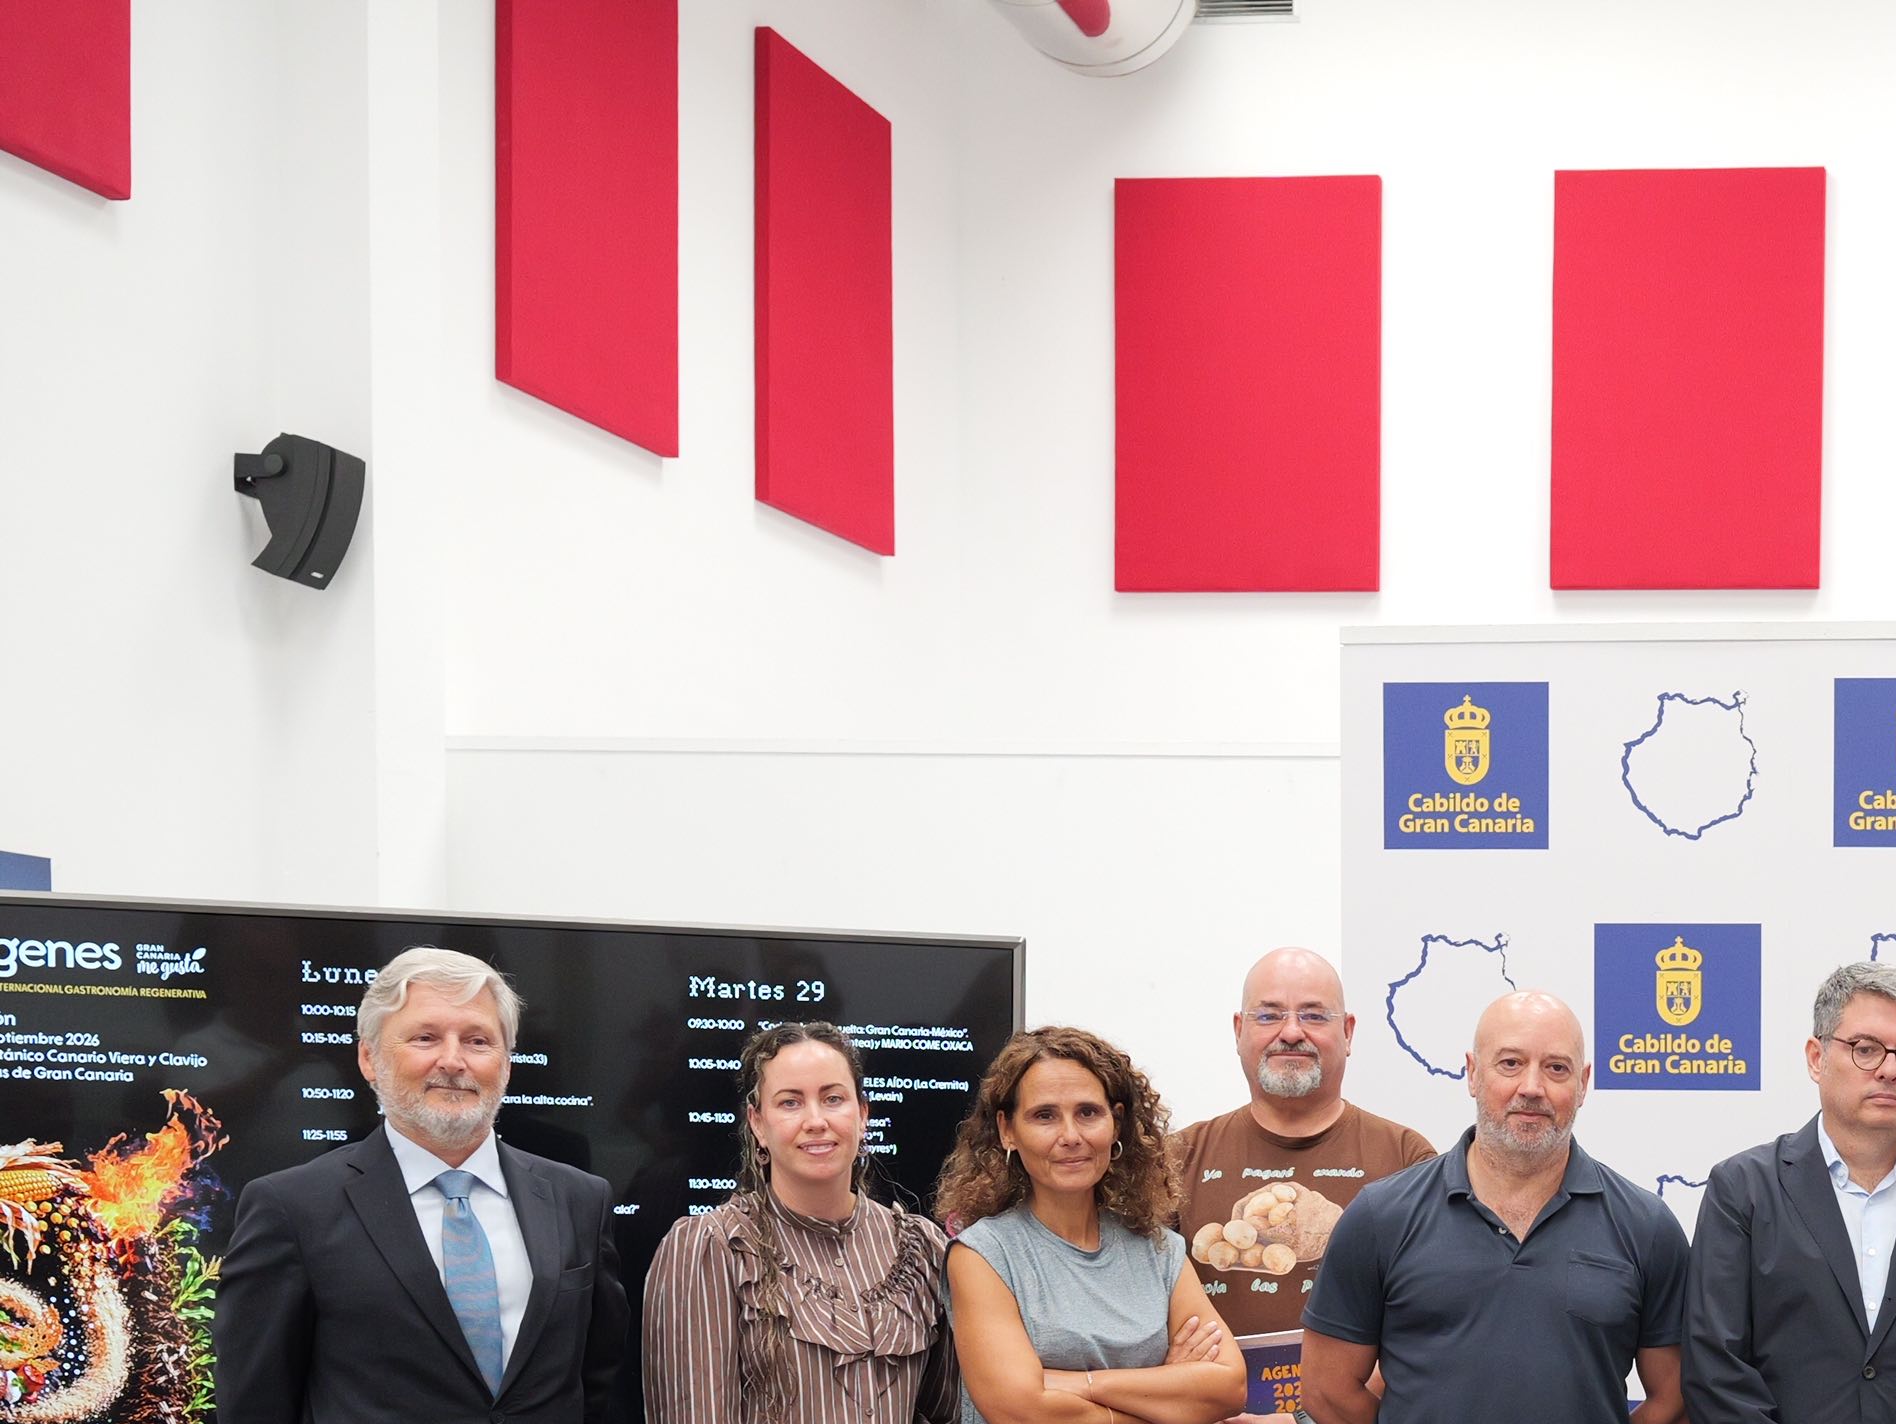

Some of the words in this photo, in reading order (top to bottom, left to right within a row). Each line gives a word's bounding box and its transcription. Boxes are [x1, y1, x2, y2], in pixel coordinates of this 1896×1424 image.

[1408, 793, 1490, 812] Cabildo
[1494, 793, 1521, 812] de
[1398, 814, 1450, 833] Gran
[1454, 814, 1535, 833] Canaria
[135, 943, 165, 952] GRAN
[135, 951, 181, 961] CANARIA
[0, 937, 123, 978] genes
[136, 960, 160, 974] me
[160, 953, 205, 980] gusta
[301, 960, 379, 985] Lune
[64, 985, 139, 997] GASTRONOMÍA
[139, 987, 207, 999] REGENERATIVA
[689, 975, 785, 1000] Martes
[796, 980, 825, 1001] 29
[865, 1024, 891, 1036] Gran
[65, 1032, 100, 1047] 2026
[881, 1039, 912, 1050] MARIO
[912, 1040, 941, 1051] COME
[1618, 1033, 1701, 1053] Cabildo
[1705, 1034, 1733, 1054] de
[46, 1048, 107, 1064] Canario
[108, 1051, 146, 1065] Viera
[147, 1054, 157, 1067] y
[159, 1052, 208, 1068] Clavijo
[1609, 1054, 1660, 1074] Gran
[1665, 1055, 1747, 1074] Canaria
[11, 1066, 32, 1080] de
[33, 1066, 72, 1080] Gran
[74, 1067, 134, 1082] Canaria
[533, 1094, 554, 1105] alta
[1201, 1279, 1228, 1296] oja
[1251, 1278, 1279, 1294] las
[1261, 1363, 1302, 1381] AGEN
[1273, 1381, 1302, 1398] 202
